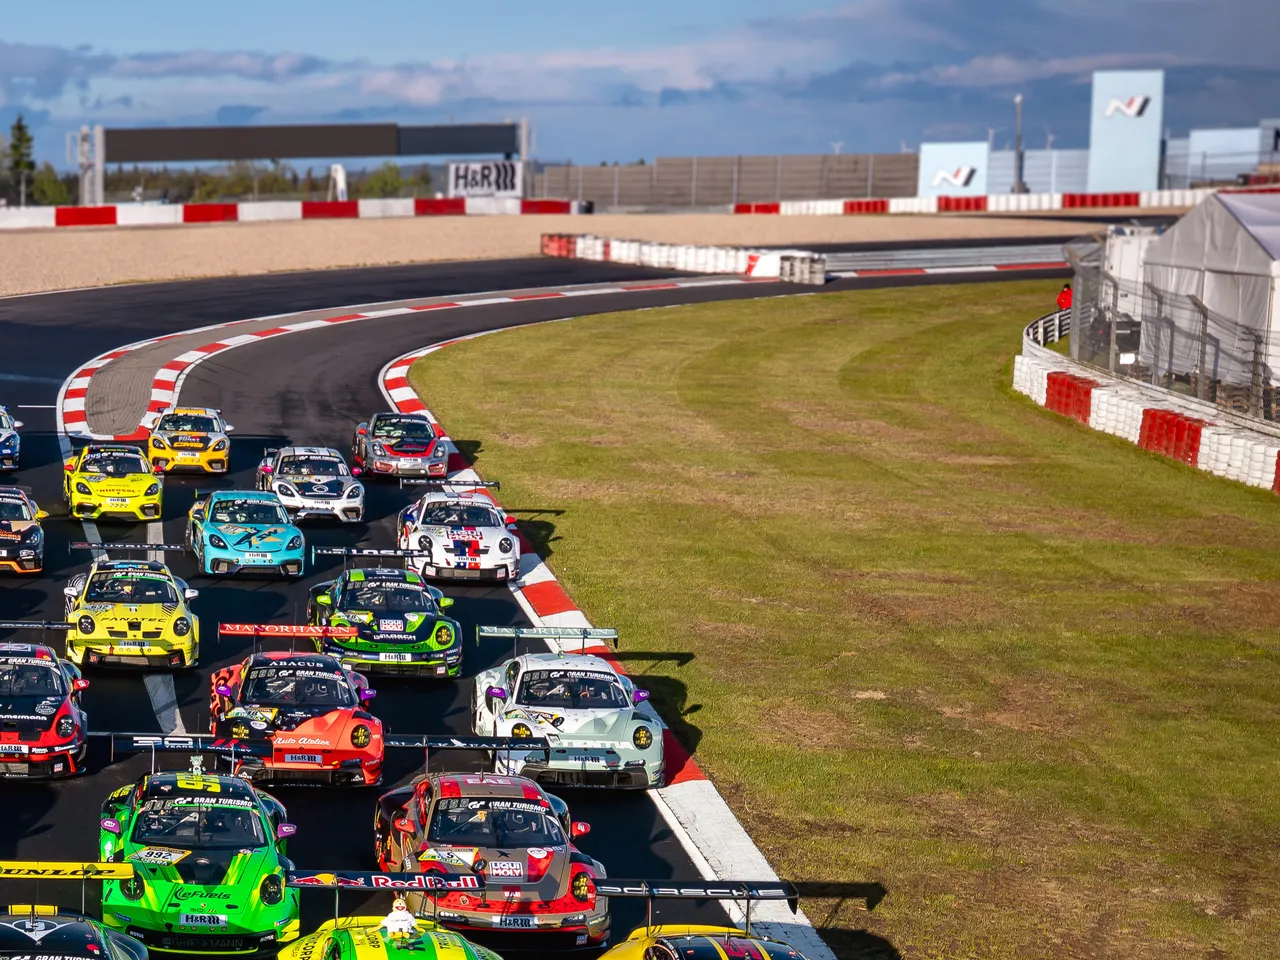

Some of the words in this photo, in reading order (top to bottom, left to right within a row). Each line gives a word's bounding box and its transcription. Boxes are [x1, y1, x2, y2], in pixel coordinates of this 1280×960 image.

[454, 163, 492, 190] H&R
[224, 623, 351, 634] MANORHAVEN
[28, 659, 56, 667] TURISMO
[269, 660, 324, 668] ABACUS
[315, 671, 344, 680] TURISMO
[586, 672, 615, 682] TURISMO
[273, 737, 296, 745] Auto
[298, 737, 331, 746] Atelier
[193, 797, 217, 805] GRAN
[218, 798, 253, 808] TURISMO
[489, 801, 512, 809] GRAN
[512, 802, 547, 812] TURISMO
[144, 850, 172, 860] 992
[490, 861, 522, 870] LIQUI
[491, 869, 522, 878] MOLY
[371, 874, 424, 889] Red
[425, 874, 479, 889] Bull
[183, 889, 232, 901] eFuels
[597, 885, 786, 897] PORSCHE
